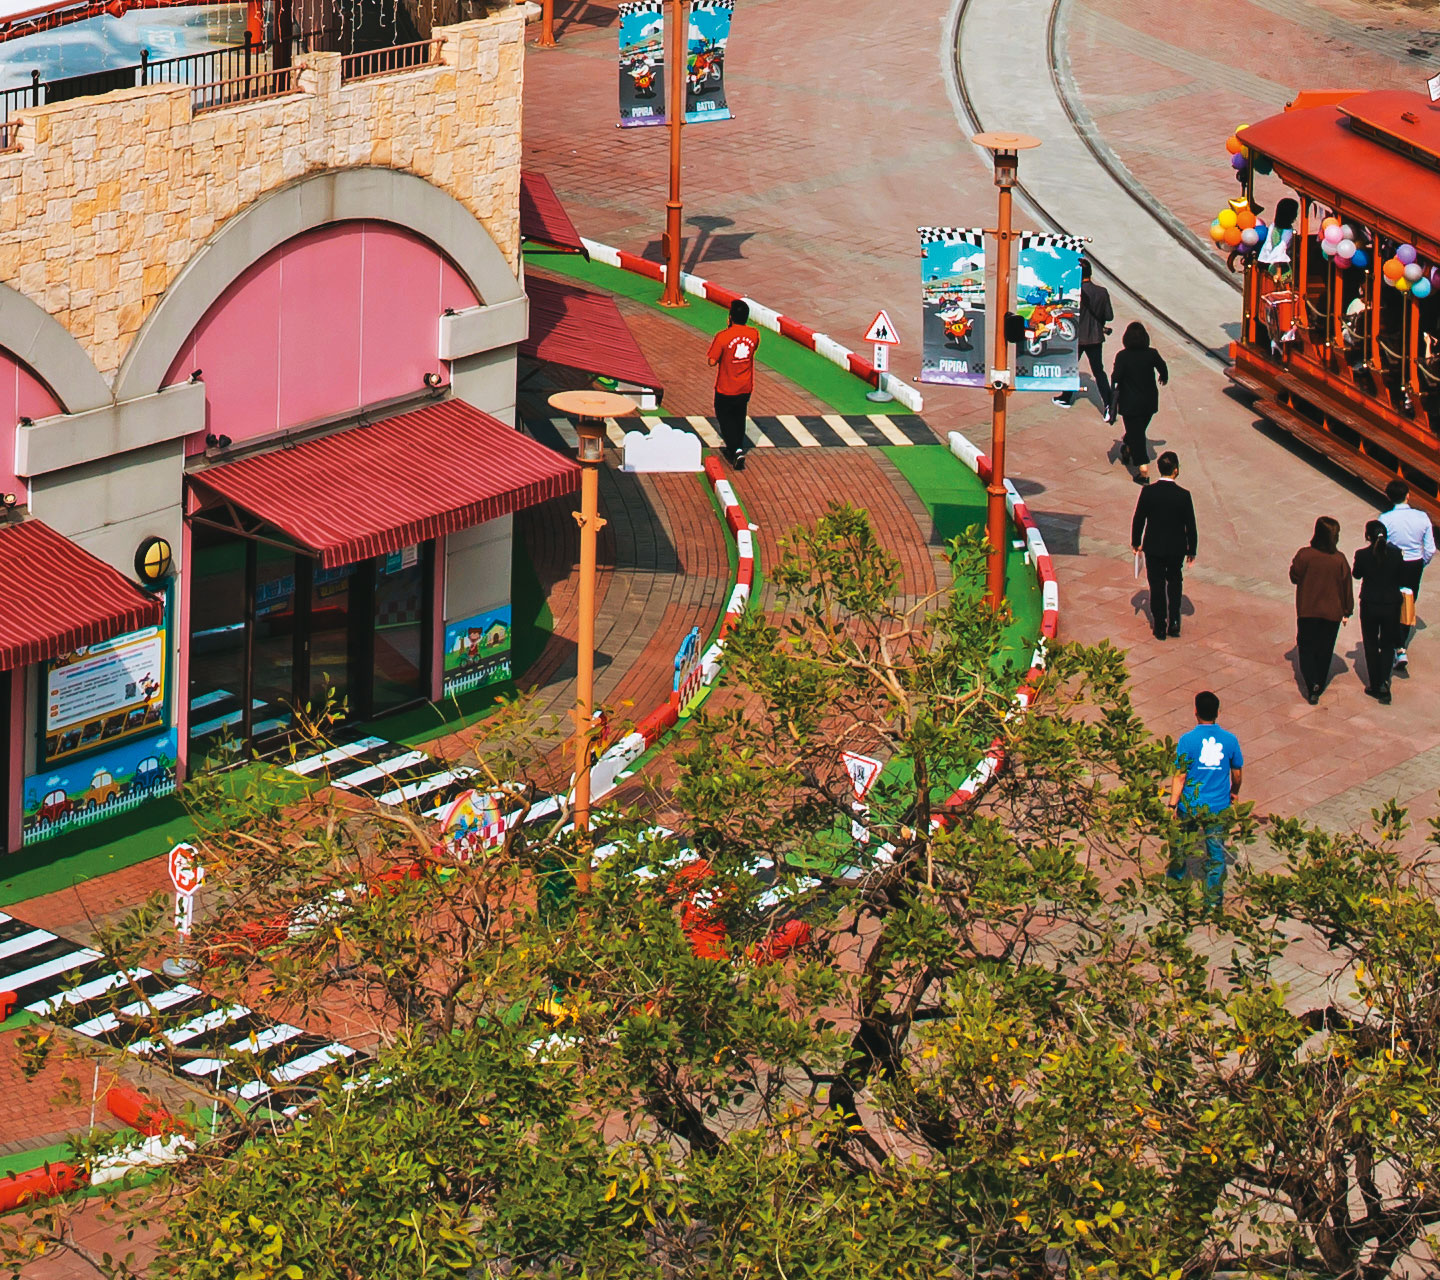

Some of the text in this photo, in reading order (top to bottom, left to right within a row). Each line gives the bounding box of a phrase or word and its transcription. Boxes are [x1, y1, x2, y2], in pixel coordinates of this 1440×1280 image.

[632, 106, 654, 117] PIPIRA
[697, 101, 716, 111] BATTO
[939, 360, 968, 373] PIPIRA
[1033, 366, 1062, 378] BATTO
